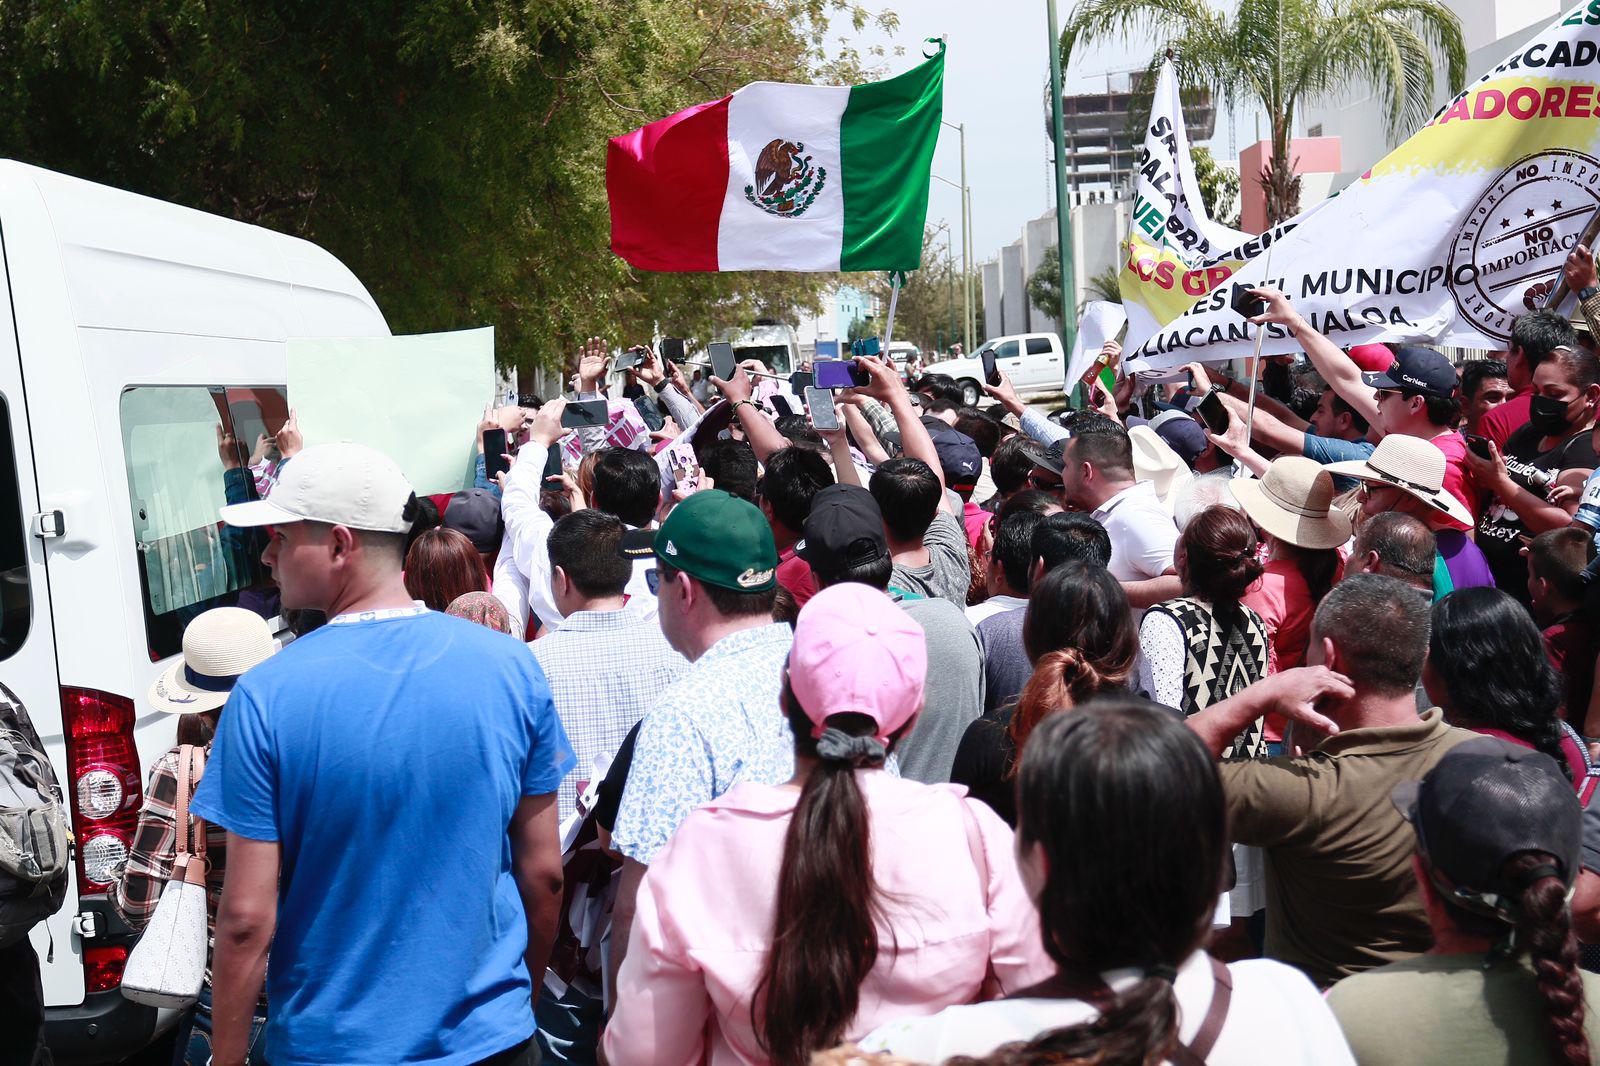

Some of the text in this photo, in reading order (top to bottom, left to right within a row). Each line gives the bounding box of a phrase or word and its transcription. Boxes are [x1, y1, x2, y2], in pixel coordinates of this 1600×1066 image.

[1426, 86, 1600, 126] ADORE
[1515, 164, 1540, 183] NO
[1551, 159, 1600, 192] IMPO
[1523, 226, 1554, 247] NO
[1301, 263, 1480, 299] MUNICIPIO
[1402, 374, 1428, 388] CarNext
